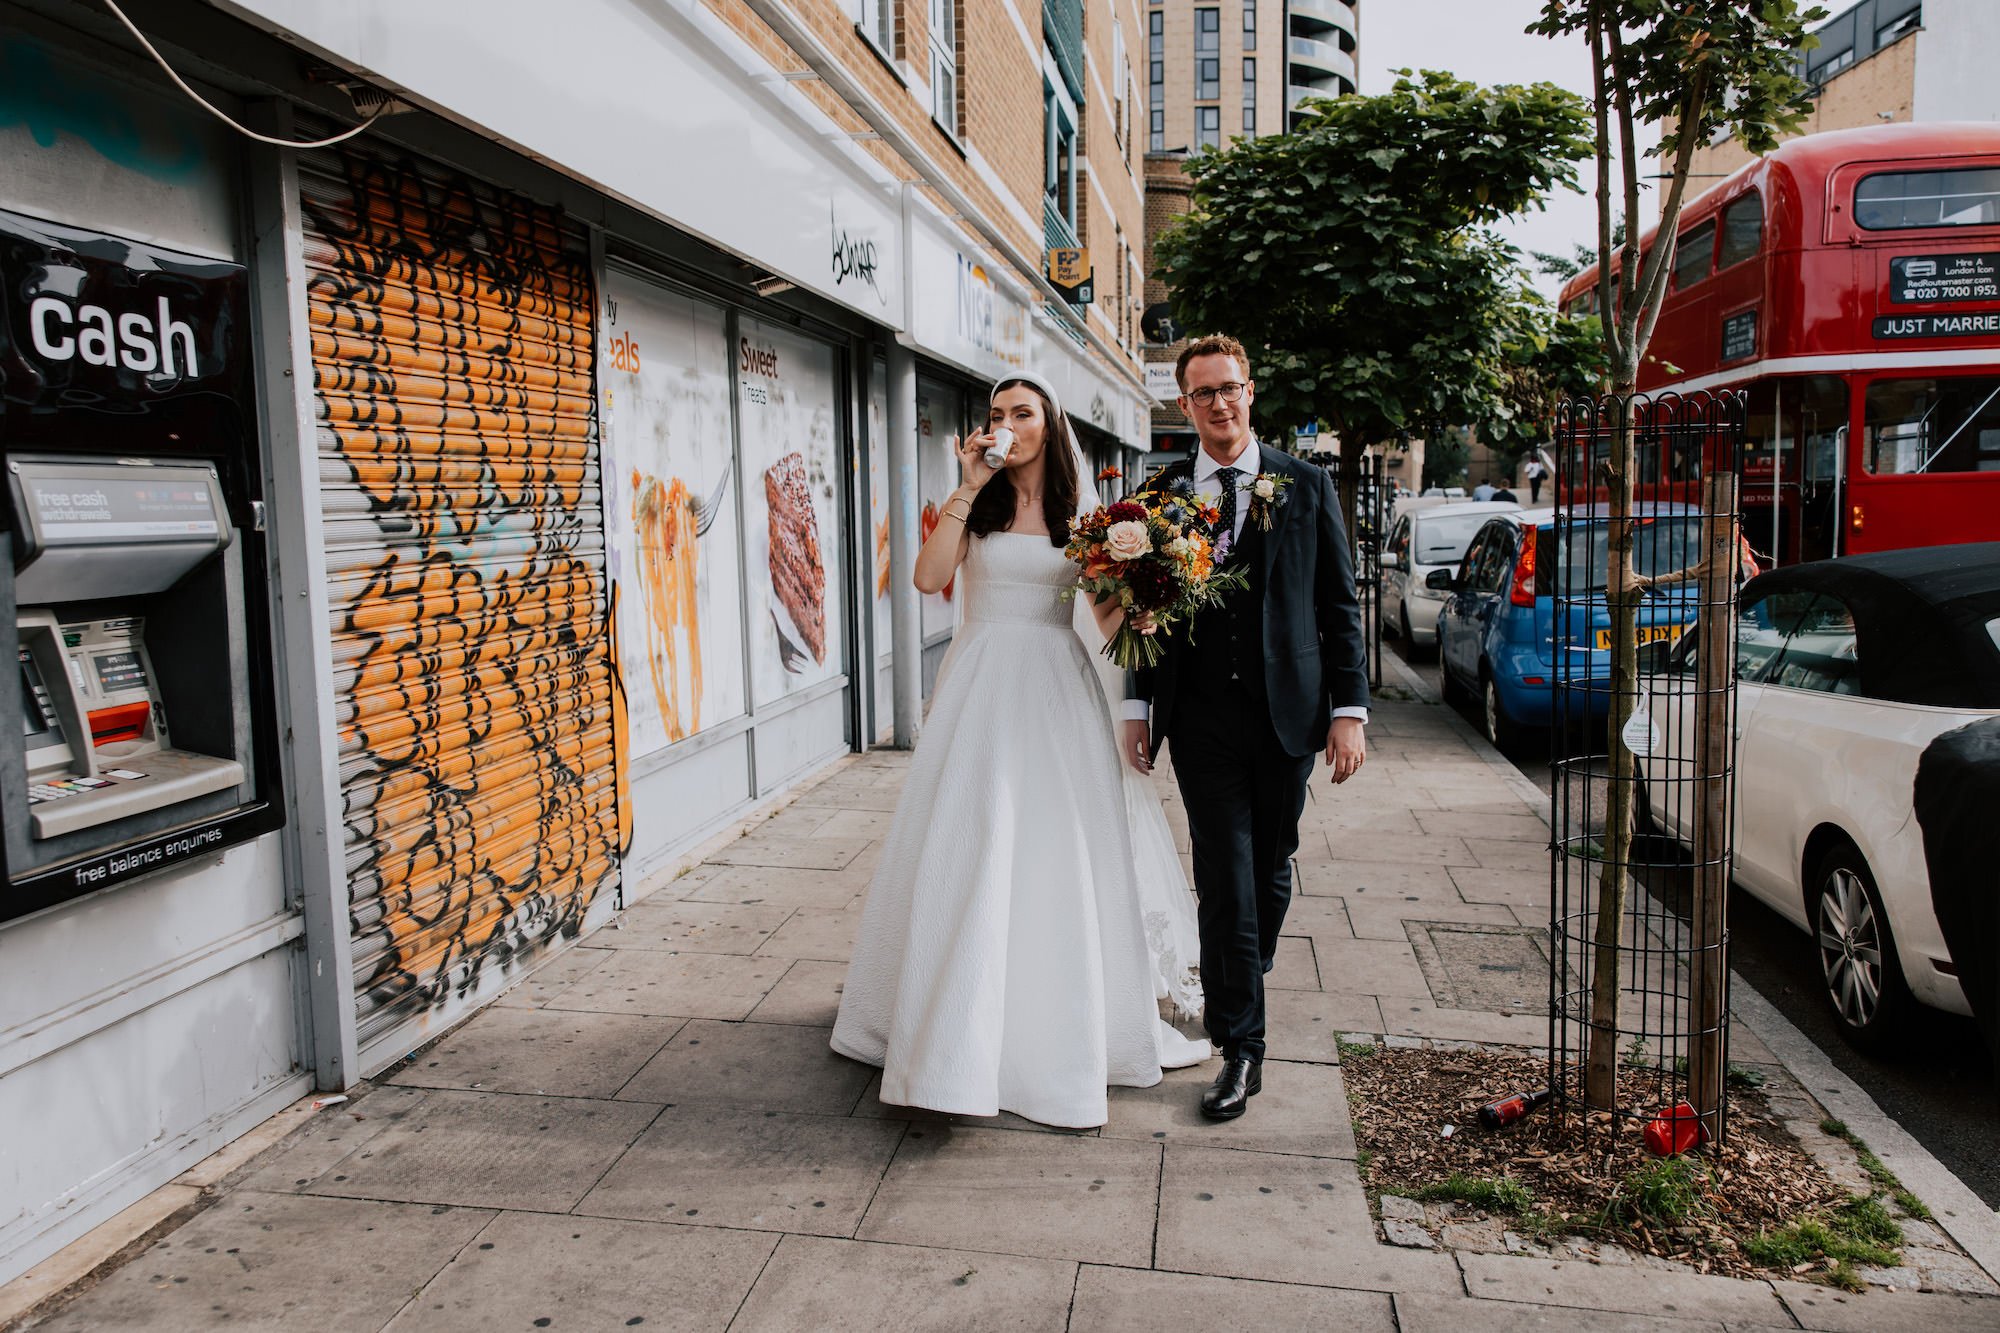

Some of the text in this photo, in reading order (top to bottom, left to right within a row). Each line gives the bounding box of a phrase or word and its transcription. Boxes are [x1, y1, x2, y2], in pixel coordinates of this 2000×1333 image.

[1955, 258, 1983, 267] Hire A
[1944, 266, 1994, 276] London Icon
[1907, 277, 1992, 288] RedRoutemaster.com
[1916, 285, 1998, 299] 020 7000 1952
[1883, 315, 2000, 335] JUST MARRIE
[30, 296, 199, 378] cash
[741, 336, 778, 379] Sweet
[1150, 368, 1171, 377] Nisa
[742, 381, 767, 405] Treats
[35, 489, 109, 507] free cash
[40, 508, 112, 521] withdrawals
[75, 828, 223, 887] free balance enquiries
